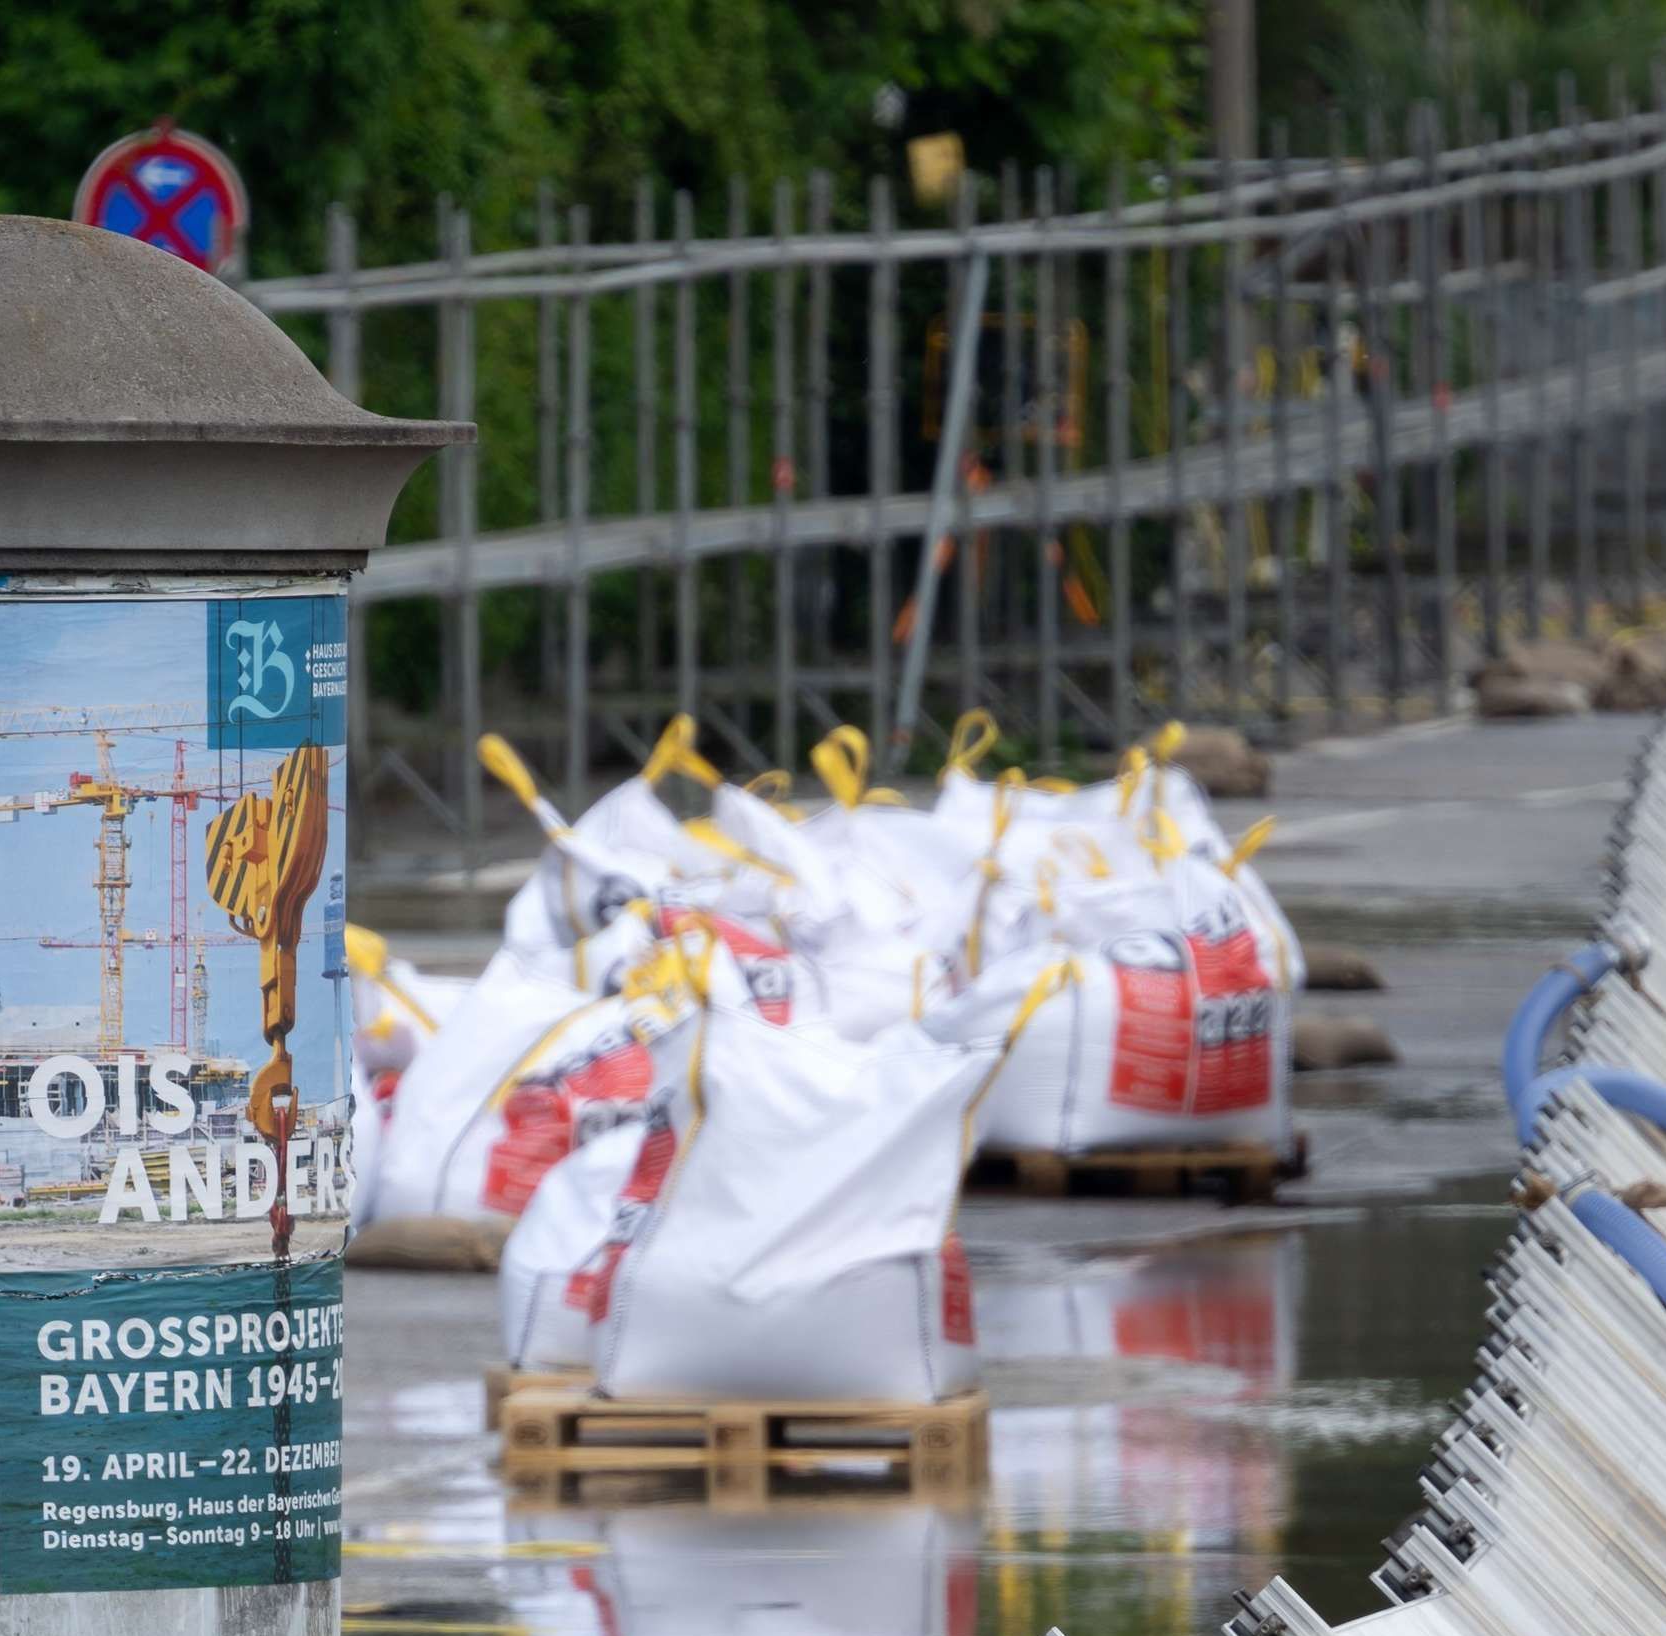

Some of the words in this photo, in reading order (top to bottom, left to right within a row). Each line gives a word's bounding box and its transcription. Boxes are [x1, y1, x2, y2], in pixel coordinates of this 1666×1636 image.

[313, 643, 332, 659] HAUS
[29, 1054, 196, 1139] OIS
[98, 1134, 357, 1224] ANDERS
[37, 1303, 343, 1361] GROSSPROJEKTE
[40, 1368, 233, 1415] BAYERN
[42, 1455, 91, 1482] 19.
[101, 1451, 196, 1480] APRIL
[221, 1448, 258, 1475] 22.
[265, 1440, 340, 1473] DEZEMBER
[43, 1500, 183, 1525] Regensburg,
[188, 1497, 234, 1515] Haus
[237, 1494, 265, 1513] der
[267, 1489, 332, 1516] Bayerischen
[43, 1530, 144, 1551] Dienstag
[166, 1526, 245, 1546] Sonntag
[251, 1521, 261, 1542] 9
[275, 1520, 291, 1540] 18
[295, 1519, 316, 1538] Uhr
